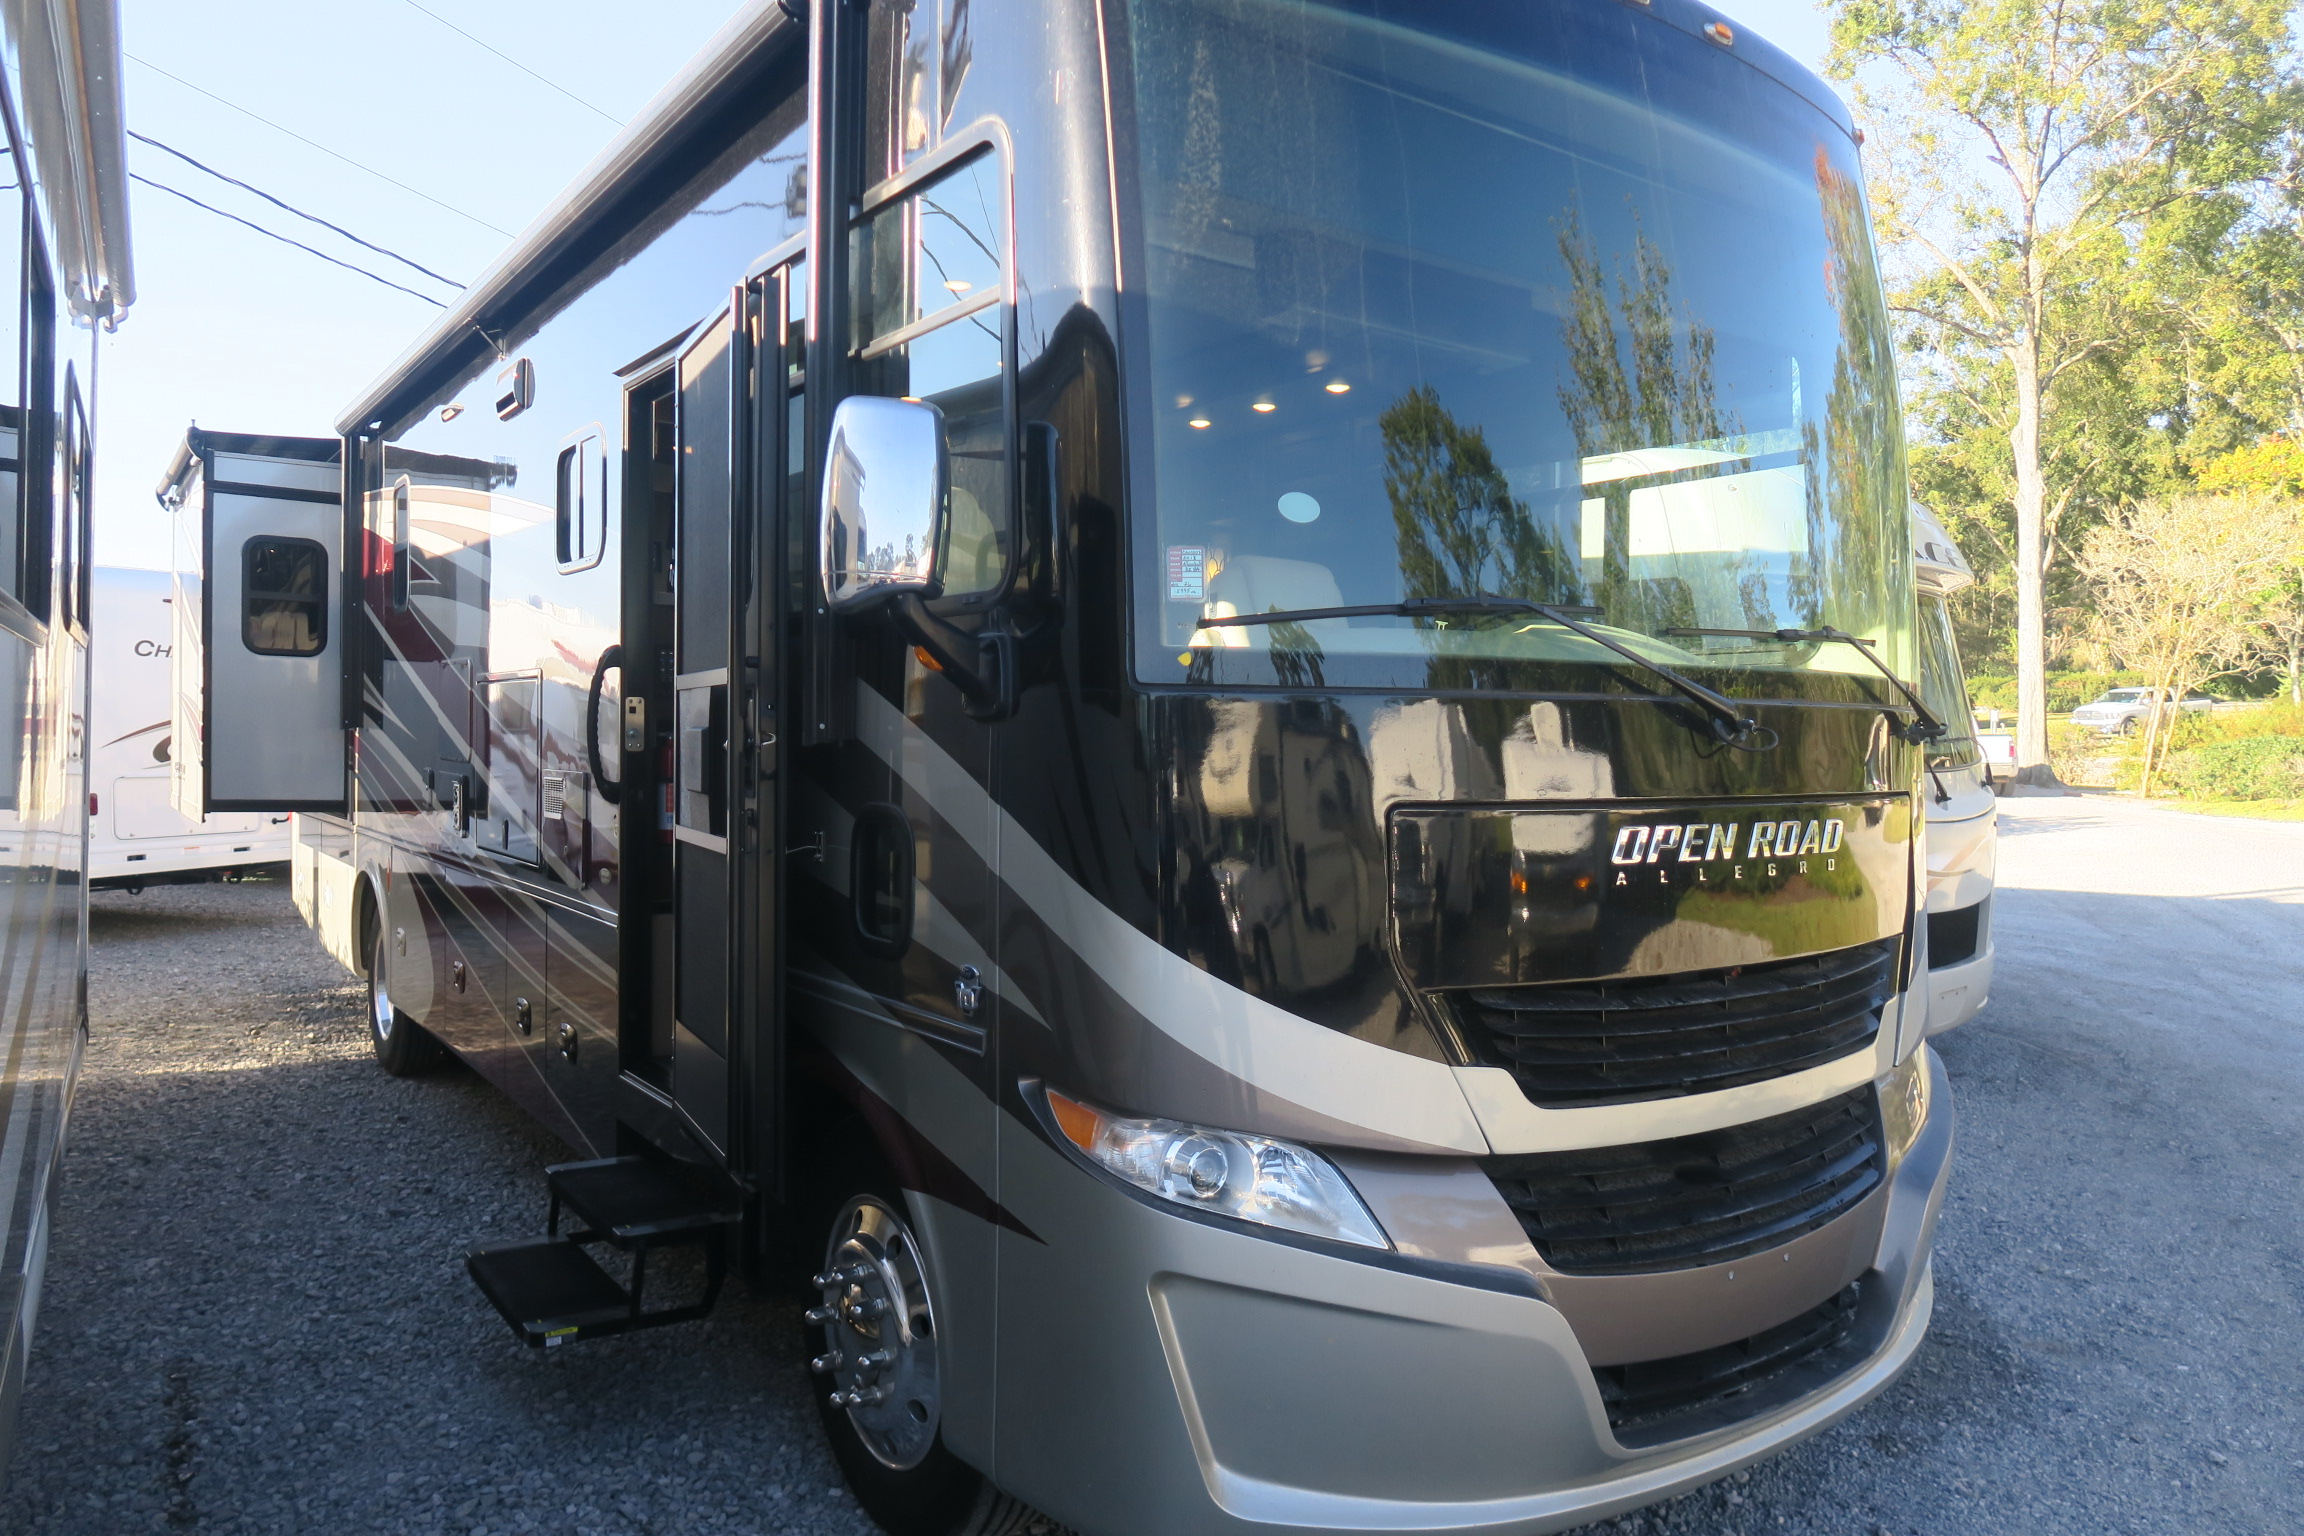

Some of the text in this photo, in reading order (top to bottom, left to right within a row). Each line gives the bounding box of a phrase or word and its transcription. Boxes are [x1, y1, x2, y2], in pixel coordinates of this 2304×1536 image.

[1611, 819, 1844, 865] OPEN ROAD
[1616, 858, 1835, 886] ALLEGRO
